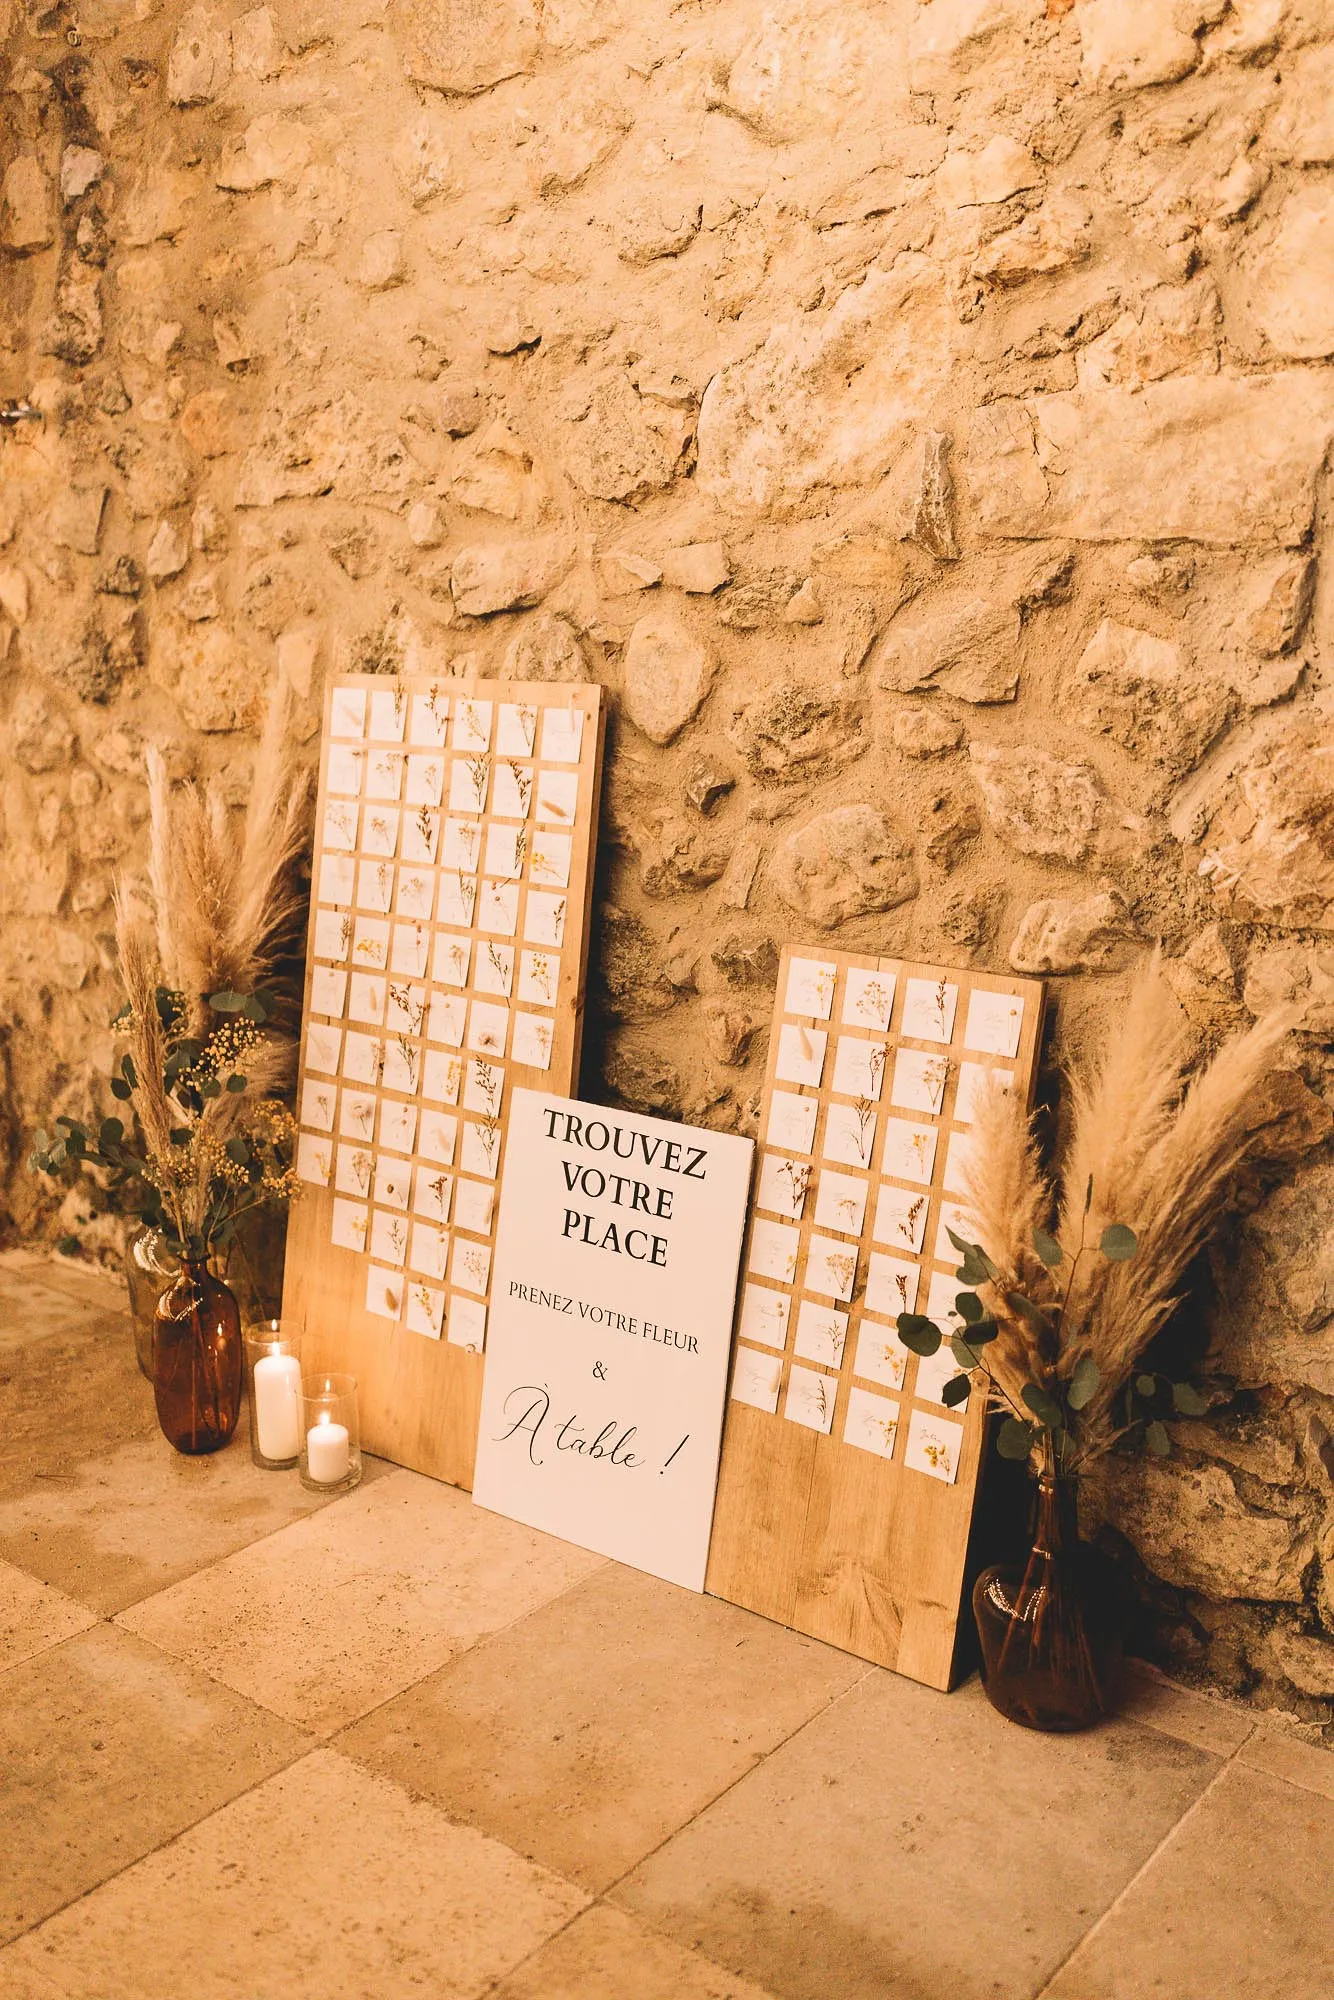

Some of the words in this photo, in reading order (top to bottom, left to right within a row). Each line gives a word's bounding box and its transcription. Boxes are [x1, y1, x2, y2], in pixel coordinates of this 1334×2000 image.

[543, 1107, 709, 1181] TROUVEZ
[560, 1160, 674, 1221] VOTRE
[560, 1208, 669, 1268] PLACE
[508, 1280, 574, 1316] PRENEZ
[577, 1300, 638, 1335] VOTRE
[642, 1320, 700, 1355] FLEUR
[592, 1360, 609, 1382] &
[491, 1382, 551, 1467] À
[553, 1414, 646, 1468] table
[658, 1434, 691, 1475] !
